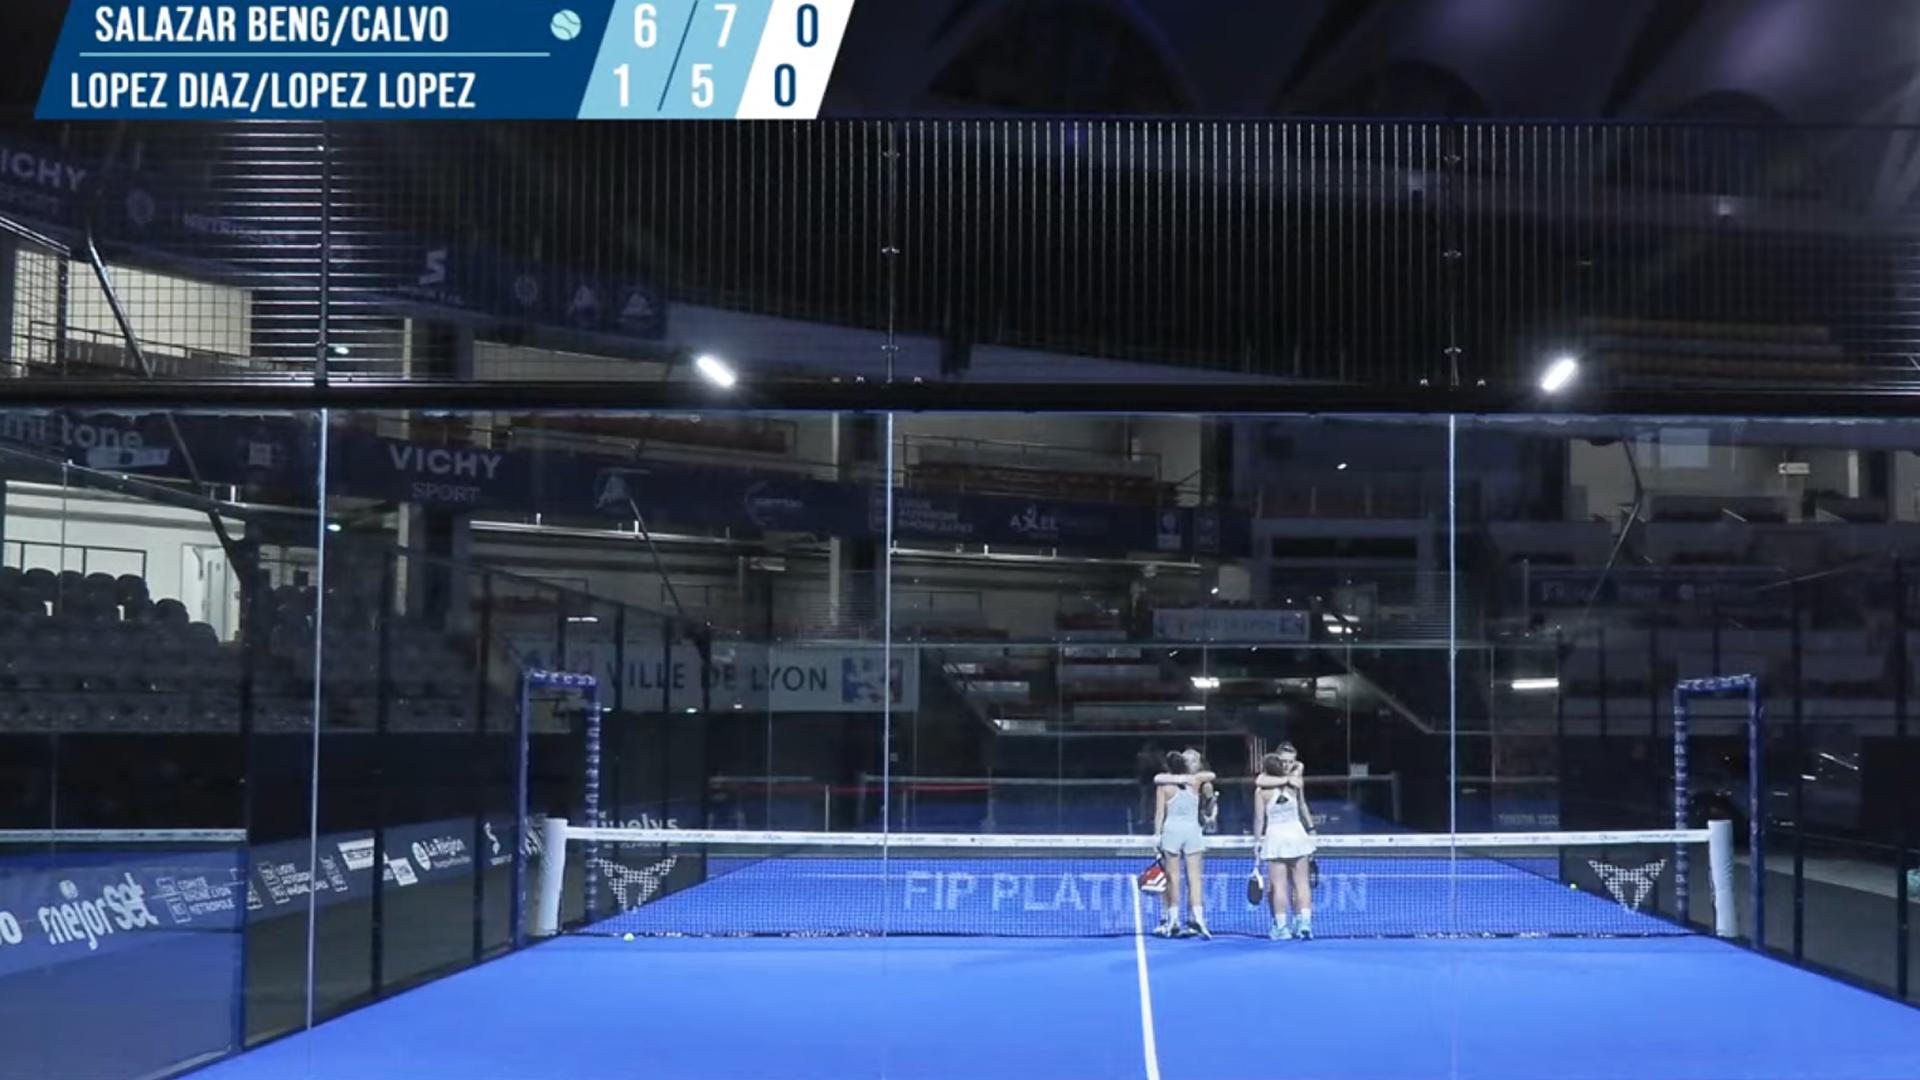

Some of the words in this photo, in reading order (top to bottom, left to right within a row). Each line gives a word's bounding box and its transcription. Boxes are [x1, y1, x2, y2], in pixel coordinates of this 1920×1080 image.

[389, 444, 502, 478] VICHY
[411, 482, 479, 502] SPORT
[750, 666, 827, 692] LYON
[904, 869, 977, 909] FIP
